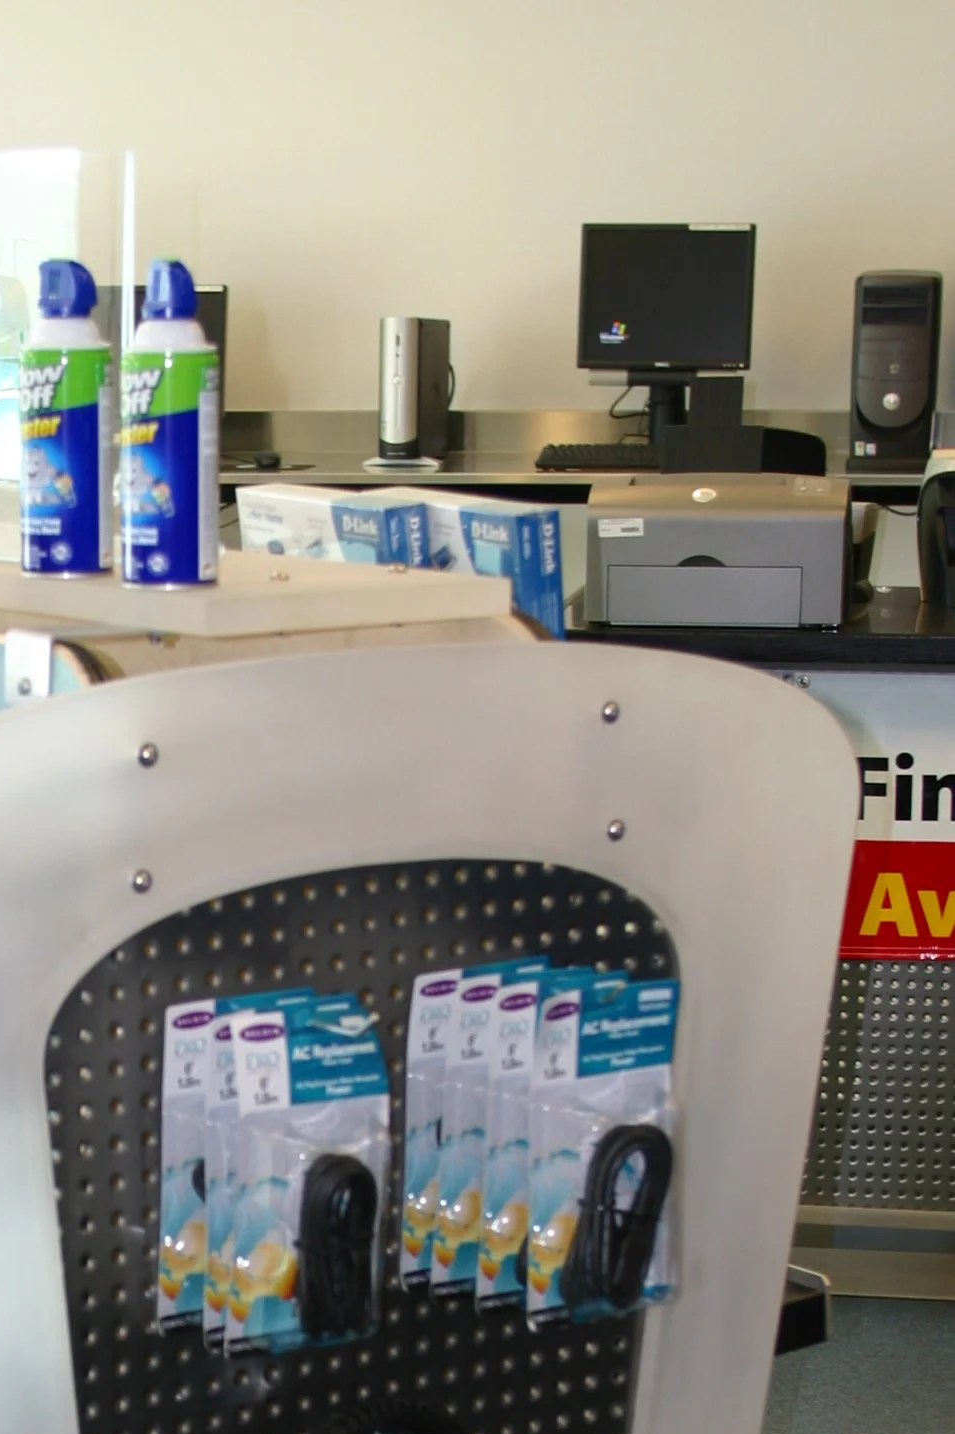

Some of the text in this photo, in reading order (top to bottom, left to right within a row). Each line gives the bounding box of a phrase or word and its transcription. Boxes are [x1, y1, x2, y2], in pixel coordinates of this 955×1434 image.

[342, 515, 379, 537] D-Link
[408, 516, 421, 567] D-Link
[471, 520, 509, 543] D-Link
[542, 522, 555, 574] D-Link
